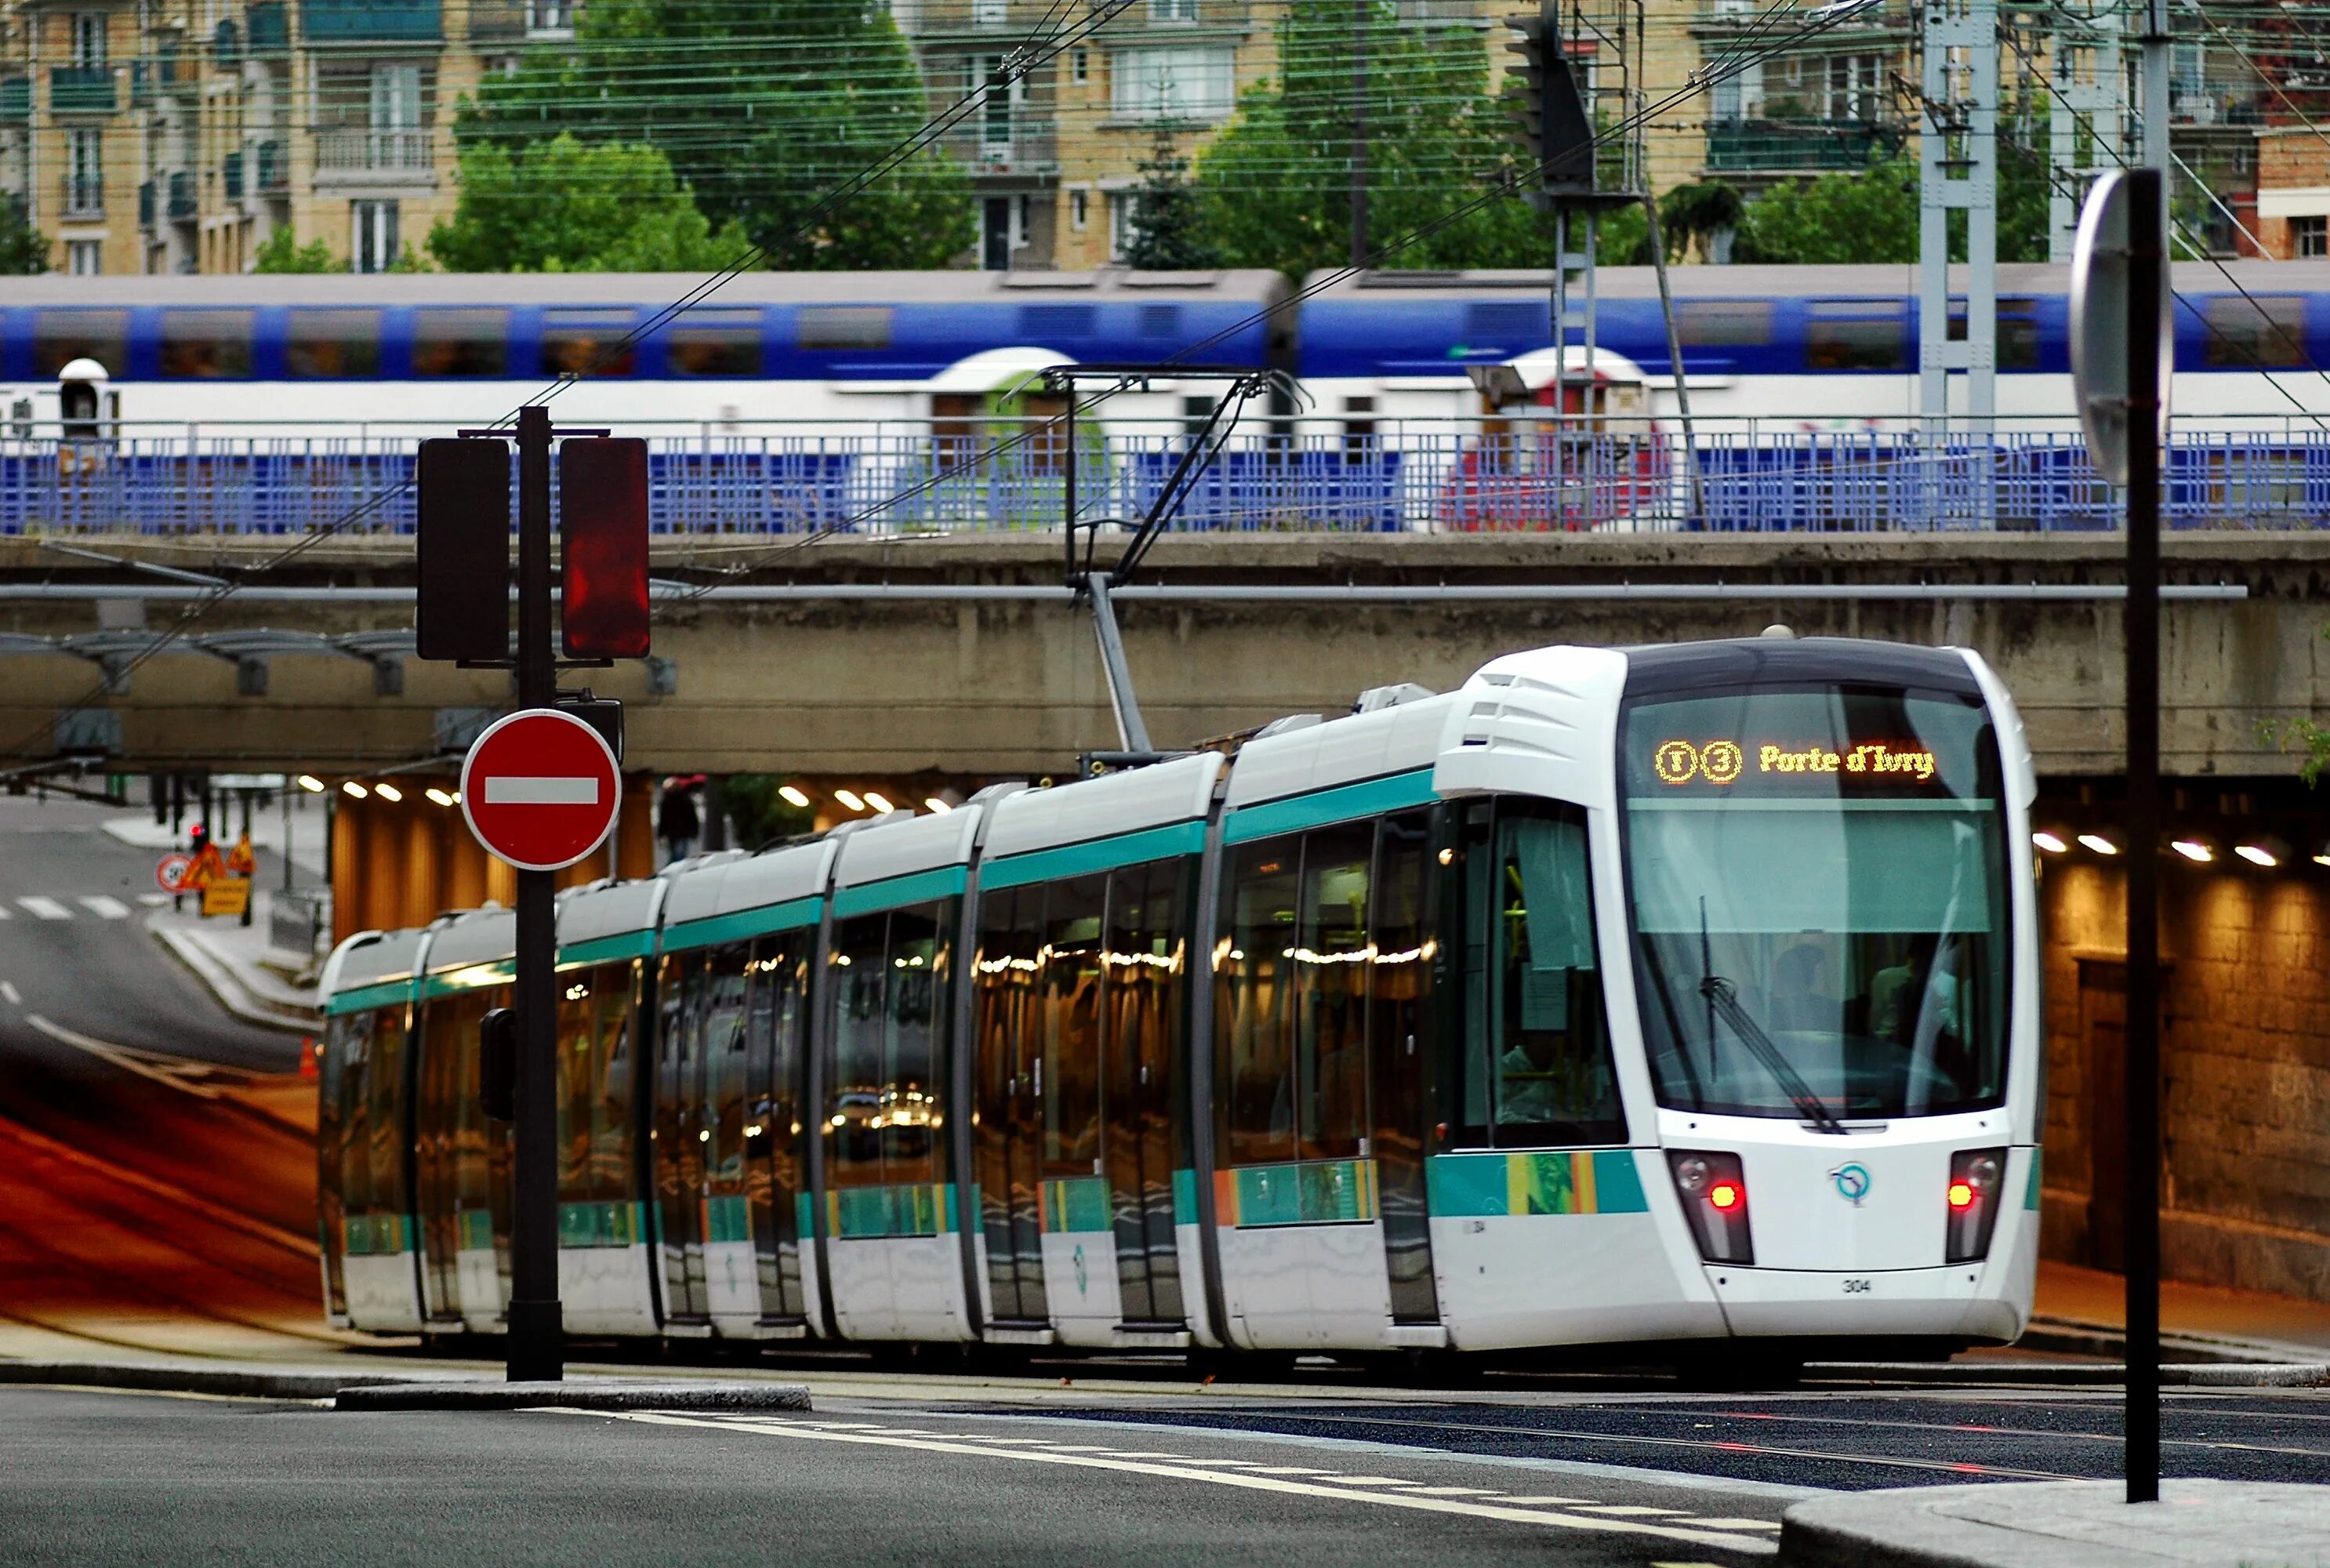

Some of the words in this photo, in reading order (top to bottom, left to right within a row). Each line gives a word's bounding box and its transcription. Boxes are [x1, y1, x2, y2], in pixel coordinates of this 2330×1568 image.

[1759, 745, 1842, 772] Porte
[1845, 745, 1935, 779] d'Ivry
[1842, 1279, 1871, 1293] 304
